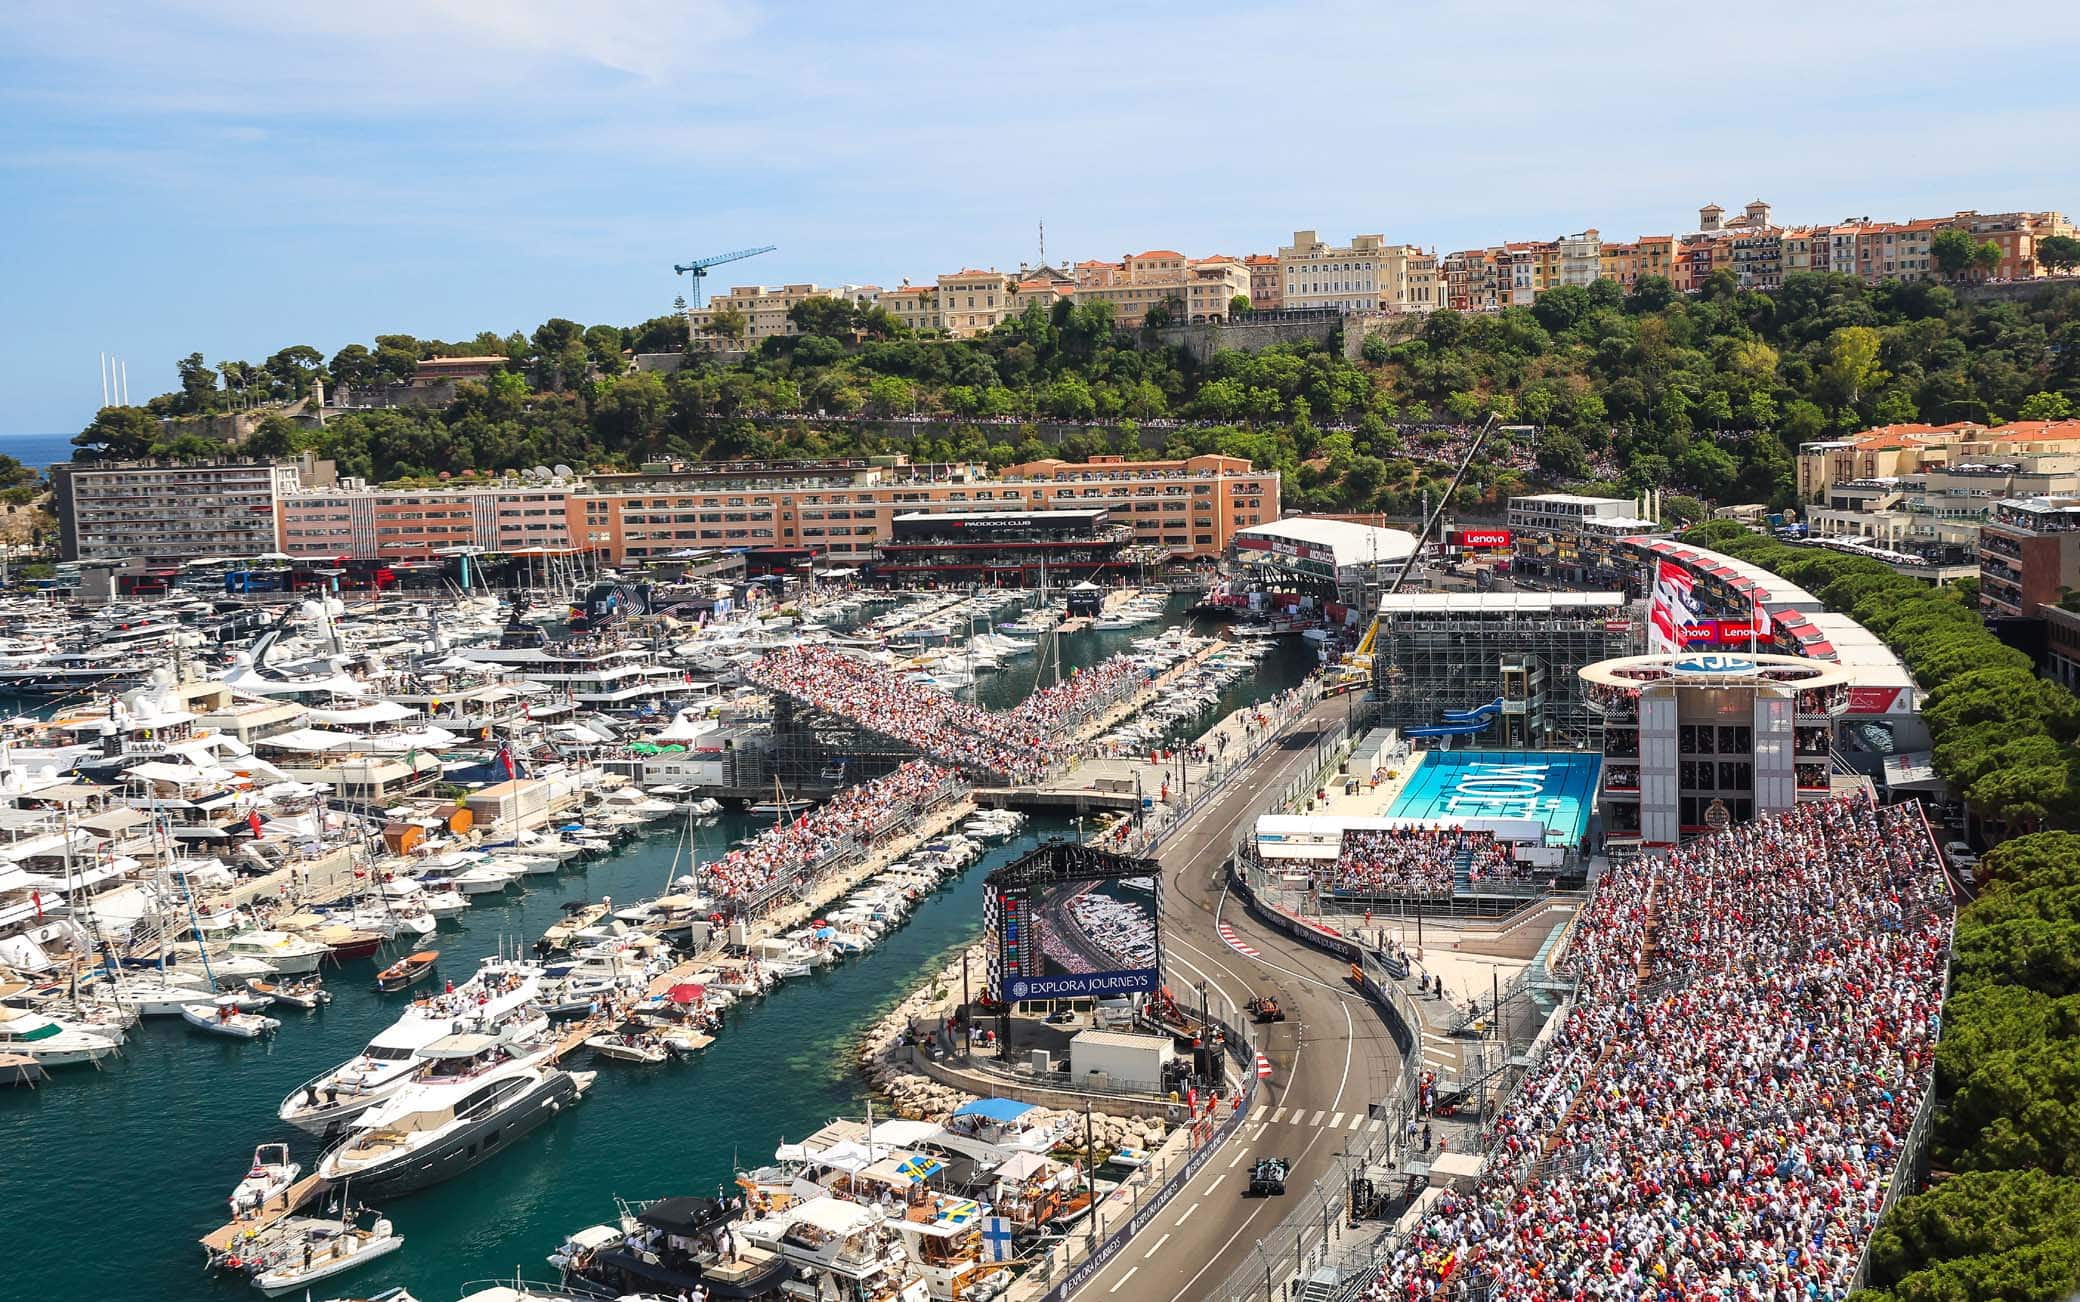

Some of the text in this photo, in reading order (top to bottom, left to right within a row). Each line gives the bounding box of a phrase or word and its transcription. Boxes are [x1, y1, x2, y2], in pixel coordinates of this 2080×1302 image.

[1467, 534, 1505, 543] Lenovo
[1272, 542, 1334, 563] WELCOME MONACO
[1681, 629, 1711, 637] novo
[1031, 975, 1149, 994] EXPLORA JOURNEYS
[1137, 1180, 1179, 1229] EXPLORA JOURNEYS
[1068, 1236, 1121, 1291] EXPLORA JOURNEYS
